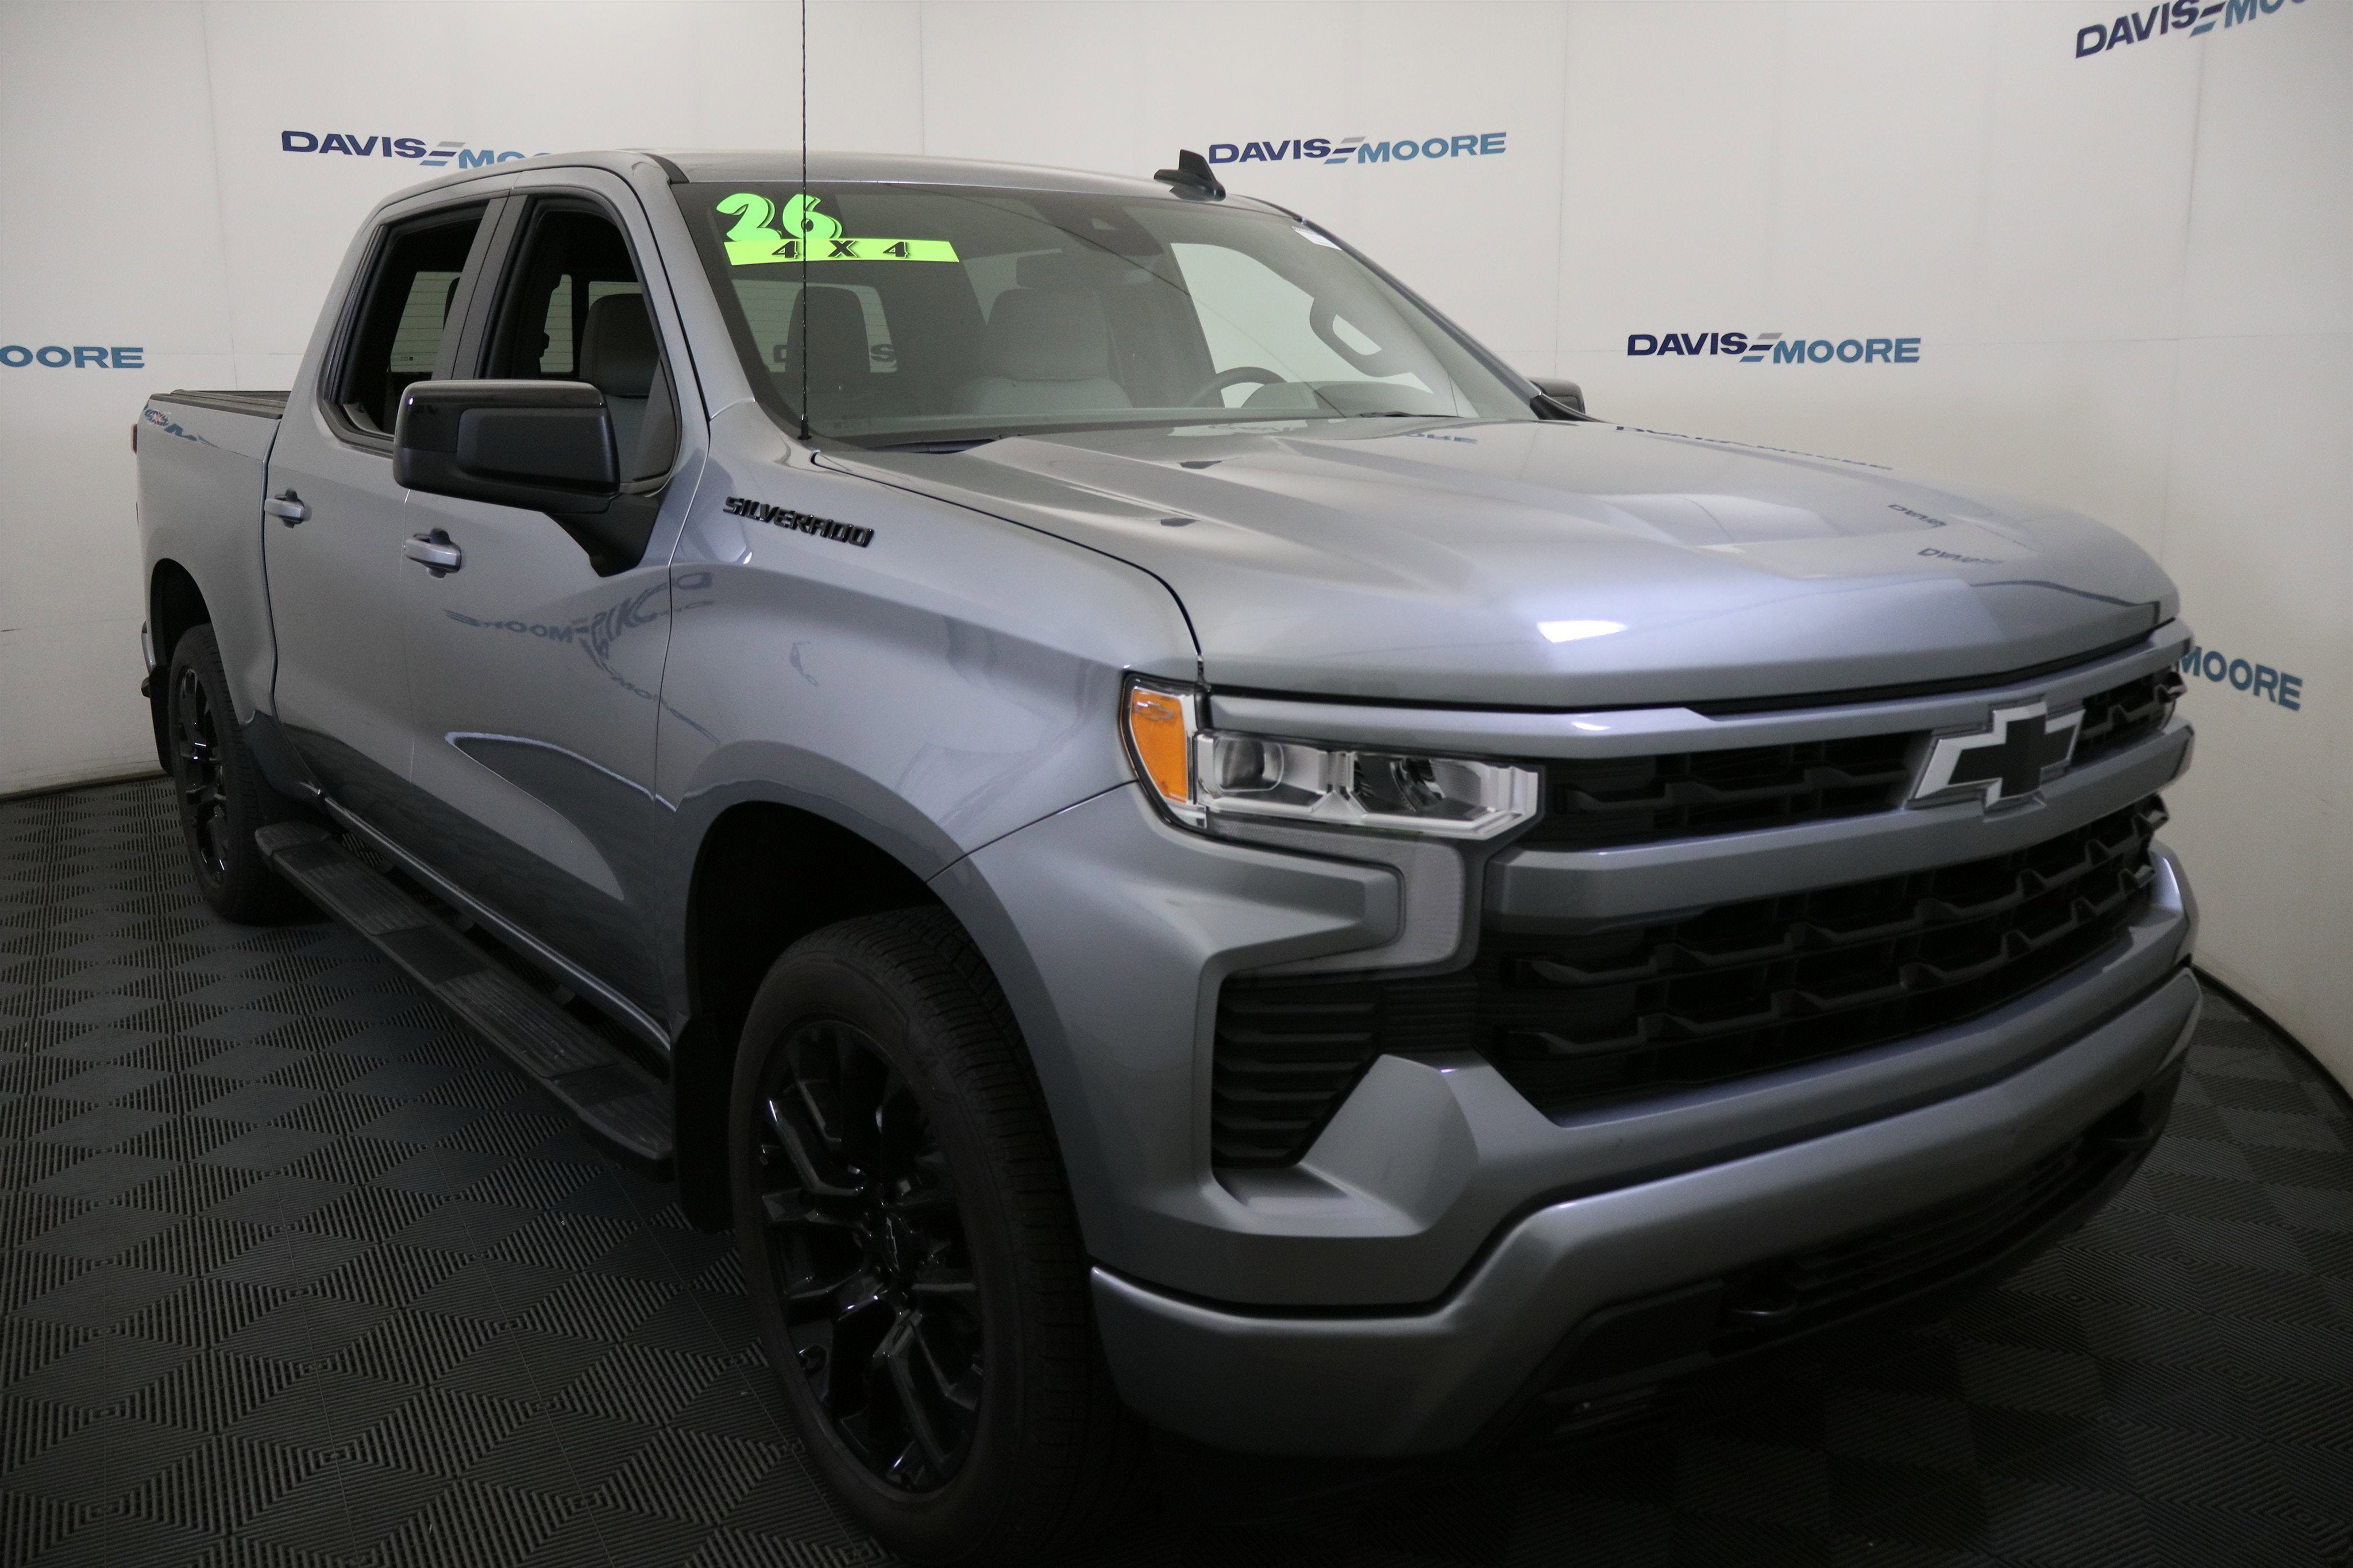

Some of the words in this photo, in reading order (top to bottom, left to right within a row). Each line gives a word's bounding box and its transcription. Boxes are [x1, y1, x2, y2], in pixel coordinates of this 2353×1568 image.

[2076, 0, 2200, 58] DAVIS
[281, 130, 427, 159] DAVIS
[1209, 138, 1332, 164] DAVIS
[1358, 132, 1507, 164] MOORE
[716, 193, 842, 241] 26
[0, 345, 145, 368] OORE
[1627, 332, 1748, 356] DAVIS
[1773, 338, 1921, 364] MOORE
[723, 496, 875, 548] SILVERADO
